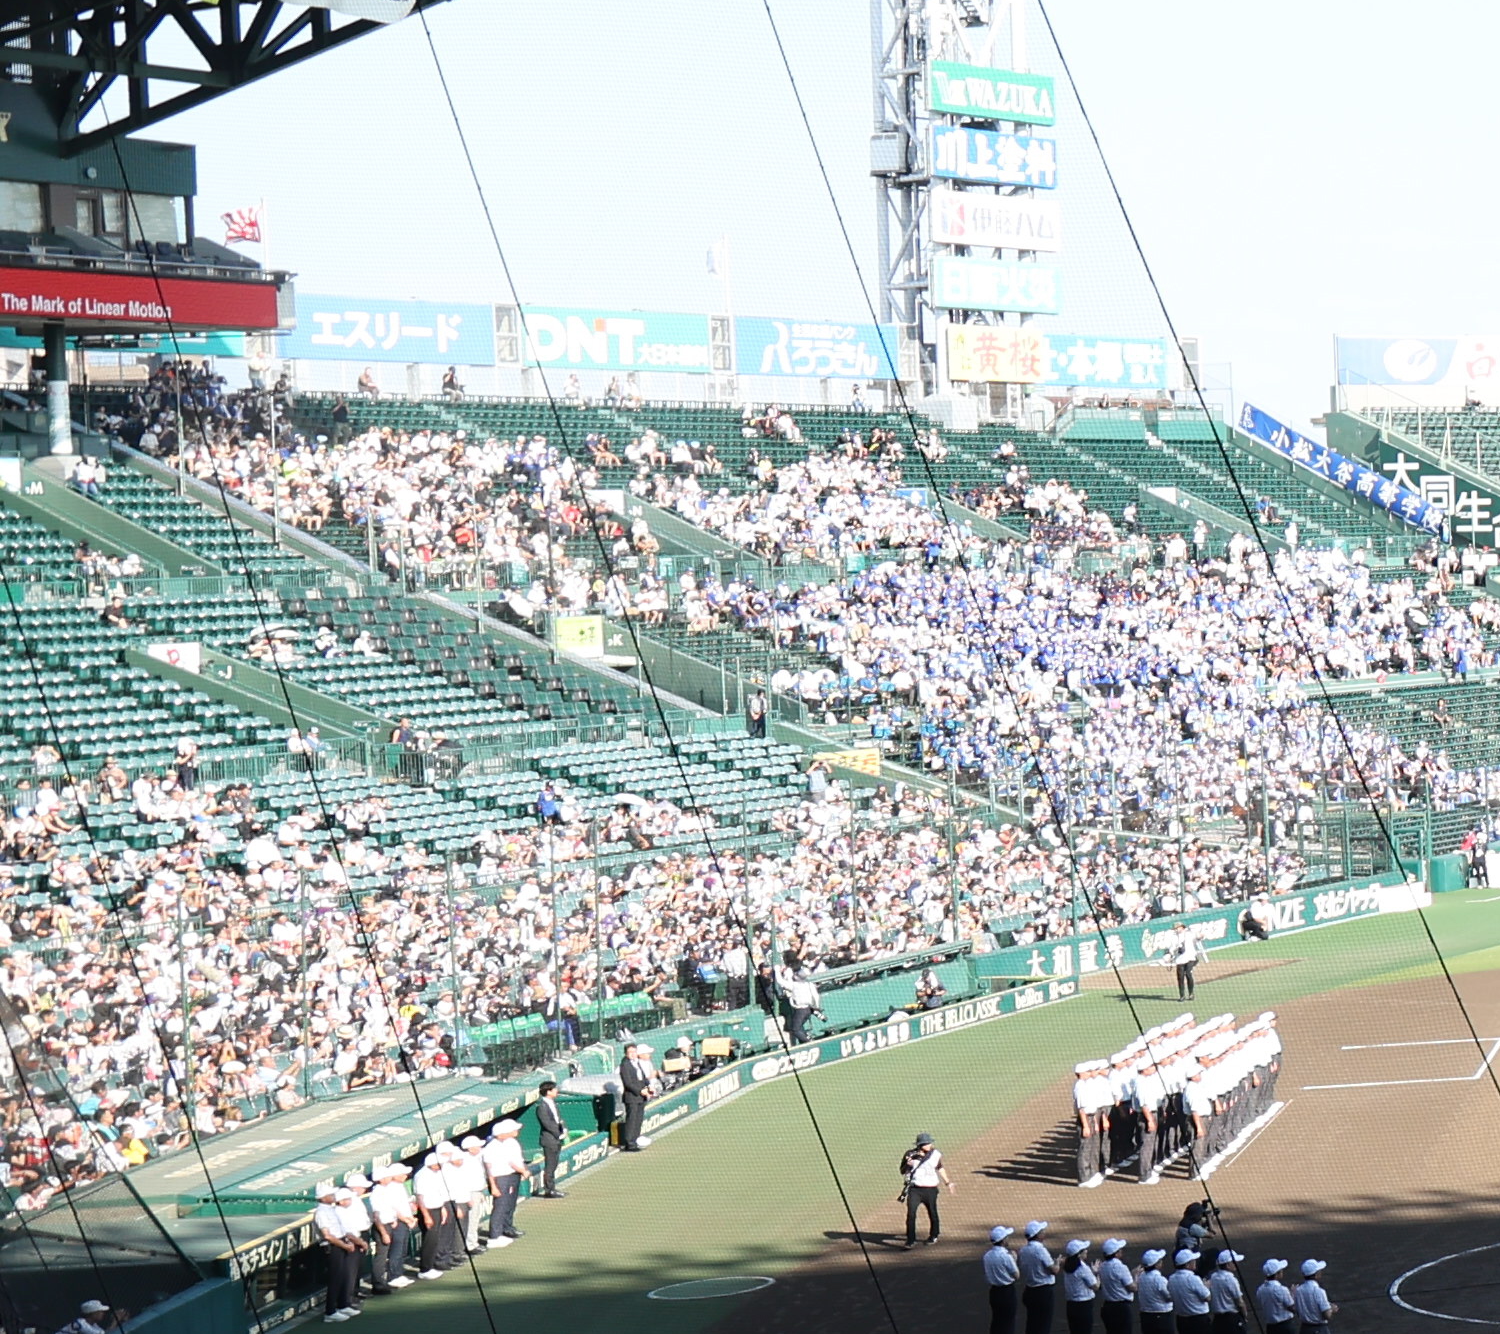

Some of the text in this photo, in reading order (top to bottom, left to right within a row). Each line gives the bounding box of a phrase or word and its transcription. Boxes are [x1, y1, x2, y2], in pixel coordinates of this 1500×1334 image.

[2, 293, 172, 319] The Mark of Linear Motion
[311, 310, 461, 353] エスリード
[790, 339, 878, 376] ろうきん
[972, 331, 1042, 378] 黄桜
[1271, 426, 1447, 535] 小松大谷高等学校
